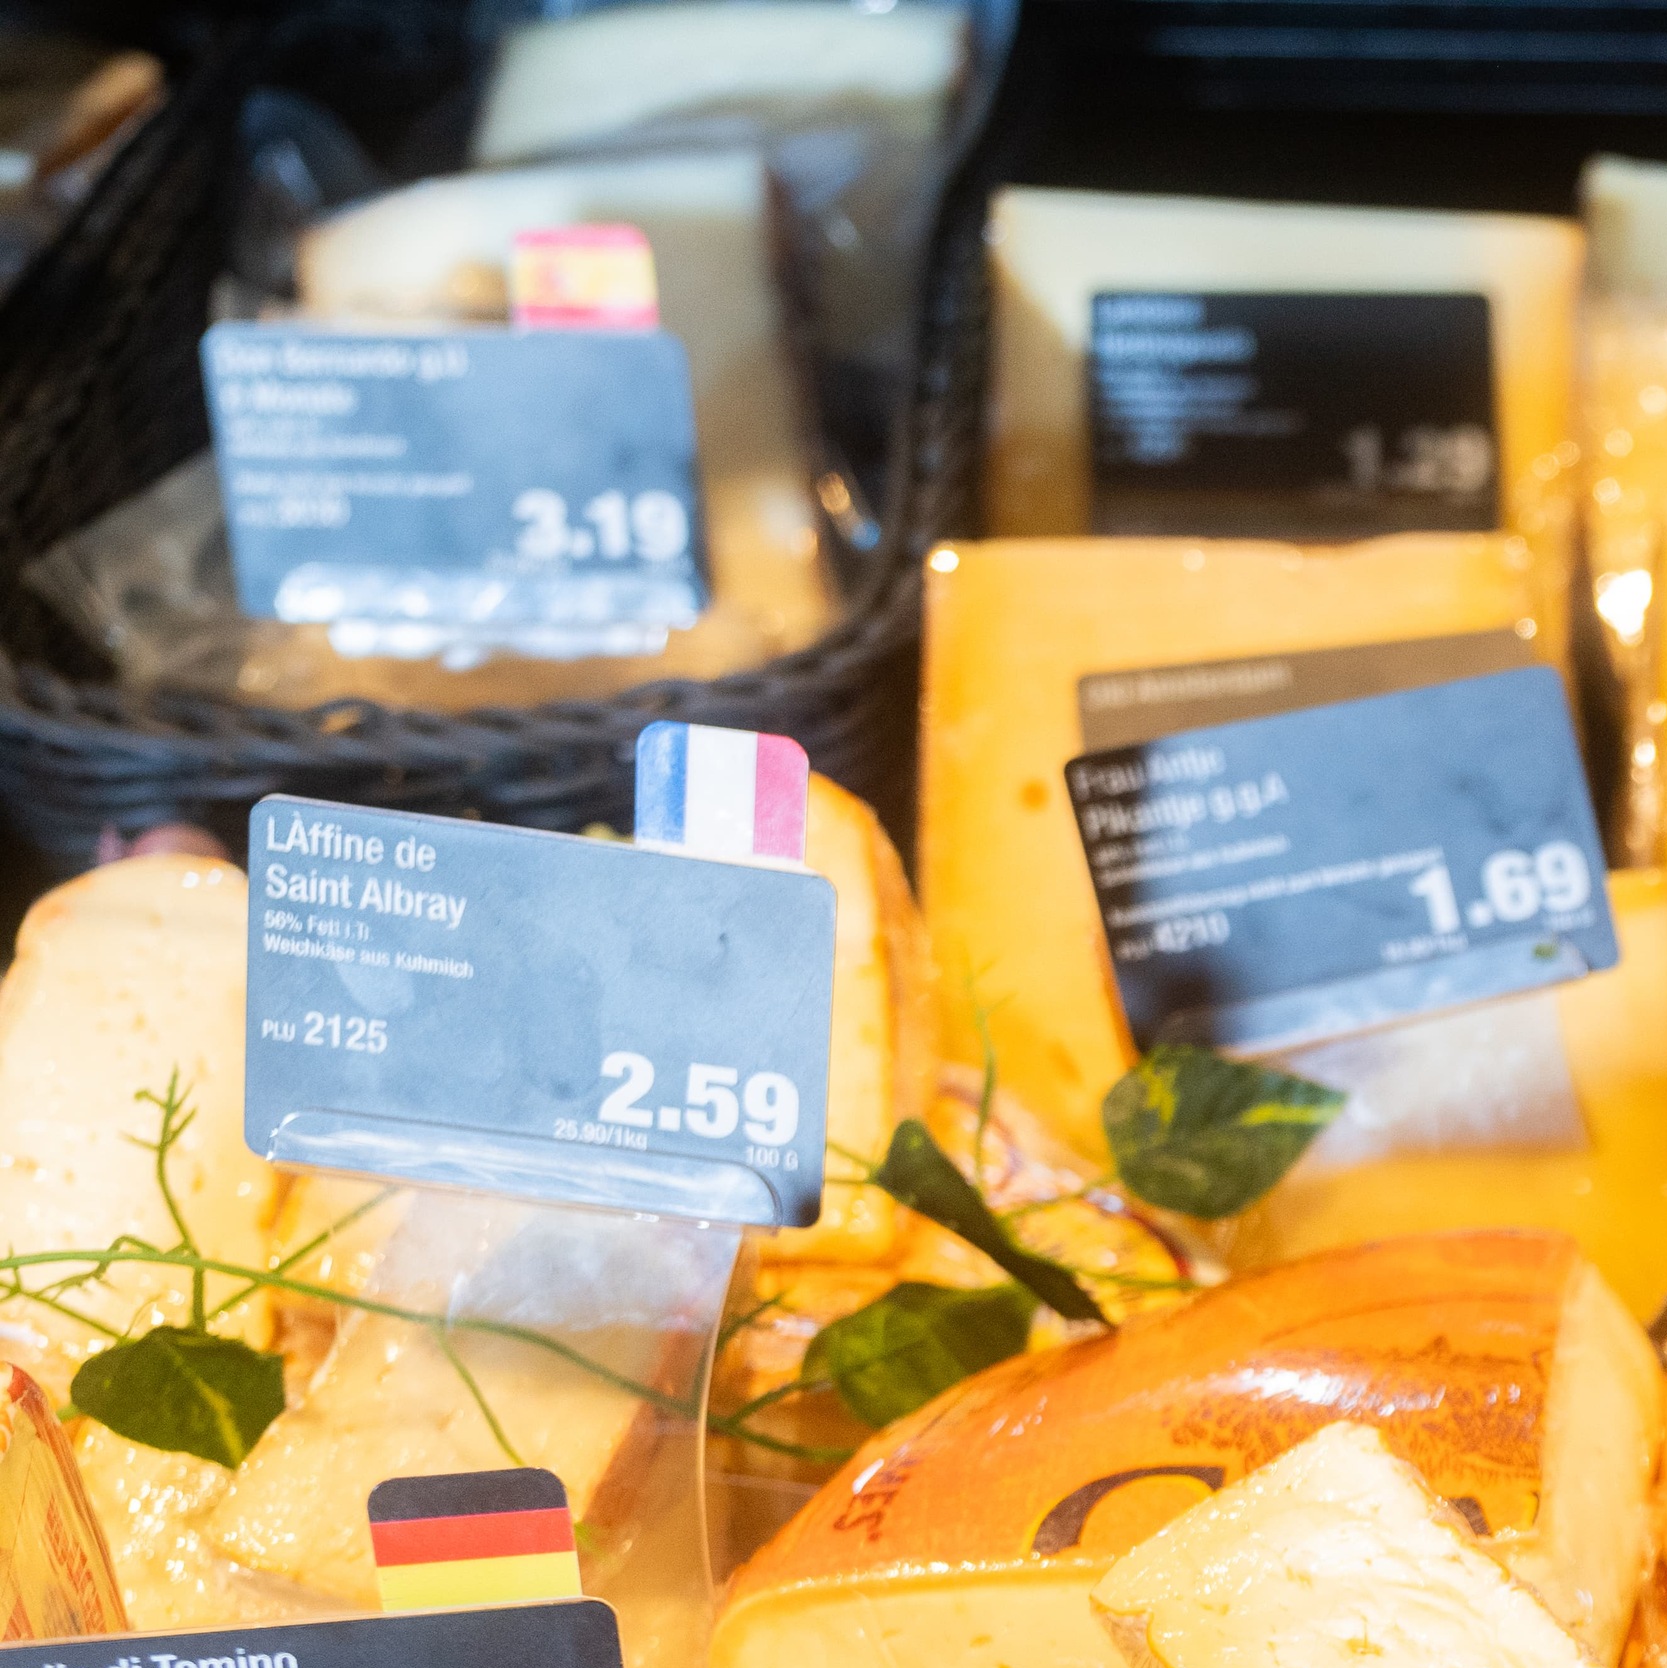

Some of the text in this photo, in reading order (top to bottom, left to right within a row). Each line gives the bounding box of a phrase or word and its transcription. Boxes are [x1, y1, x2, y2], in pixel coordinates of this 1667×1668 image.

[512, 488, 690, 560] 3.19
[395, 838, 436, 872] de
[264, 863, 467, 931] Saint Albray
[1409, 840, 1594, 936] 1.69
[307, 914, 341, 938] Fett
[263, 933, 474, 980] Weichkäse aus Kuhmilch
[261, 1010, 388, 1054] PLU 2125
[599, 1051, 799, 1147] 2.59
[744, 1144, 780, 1169] 100
[784, 1148, 799, 1170] G
